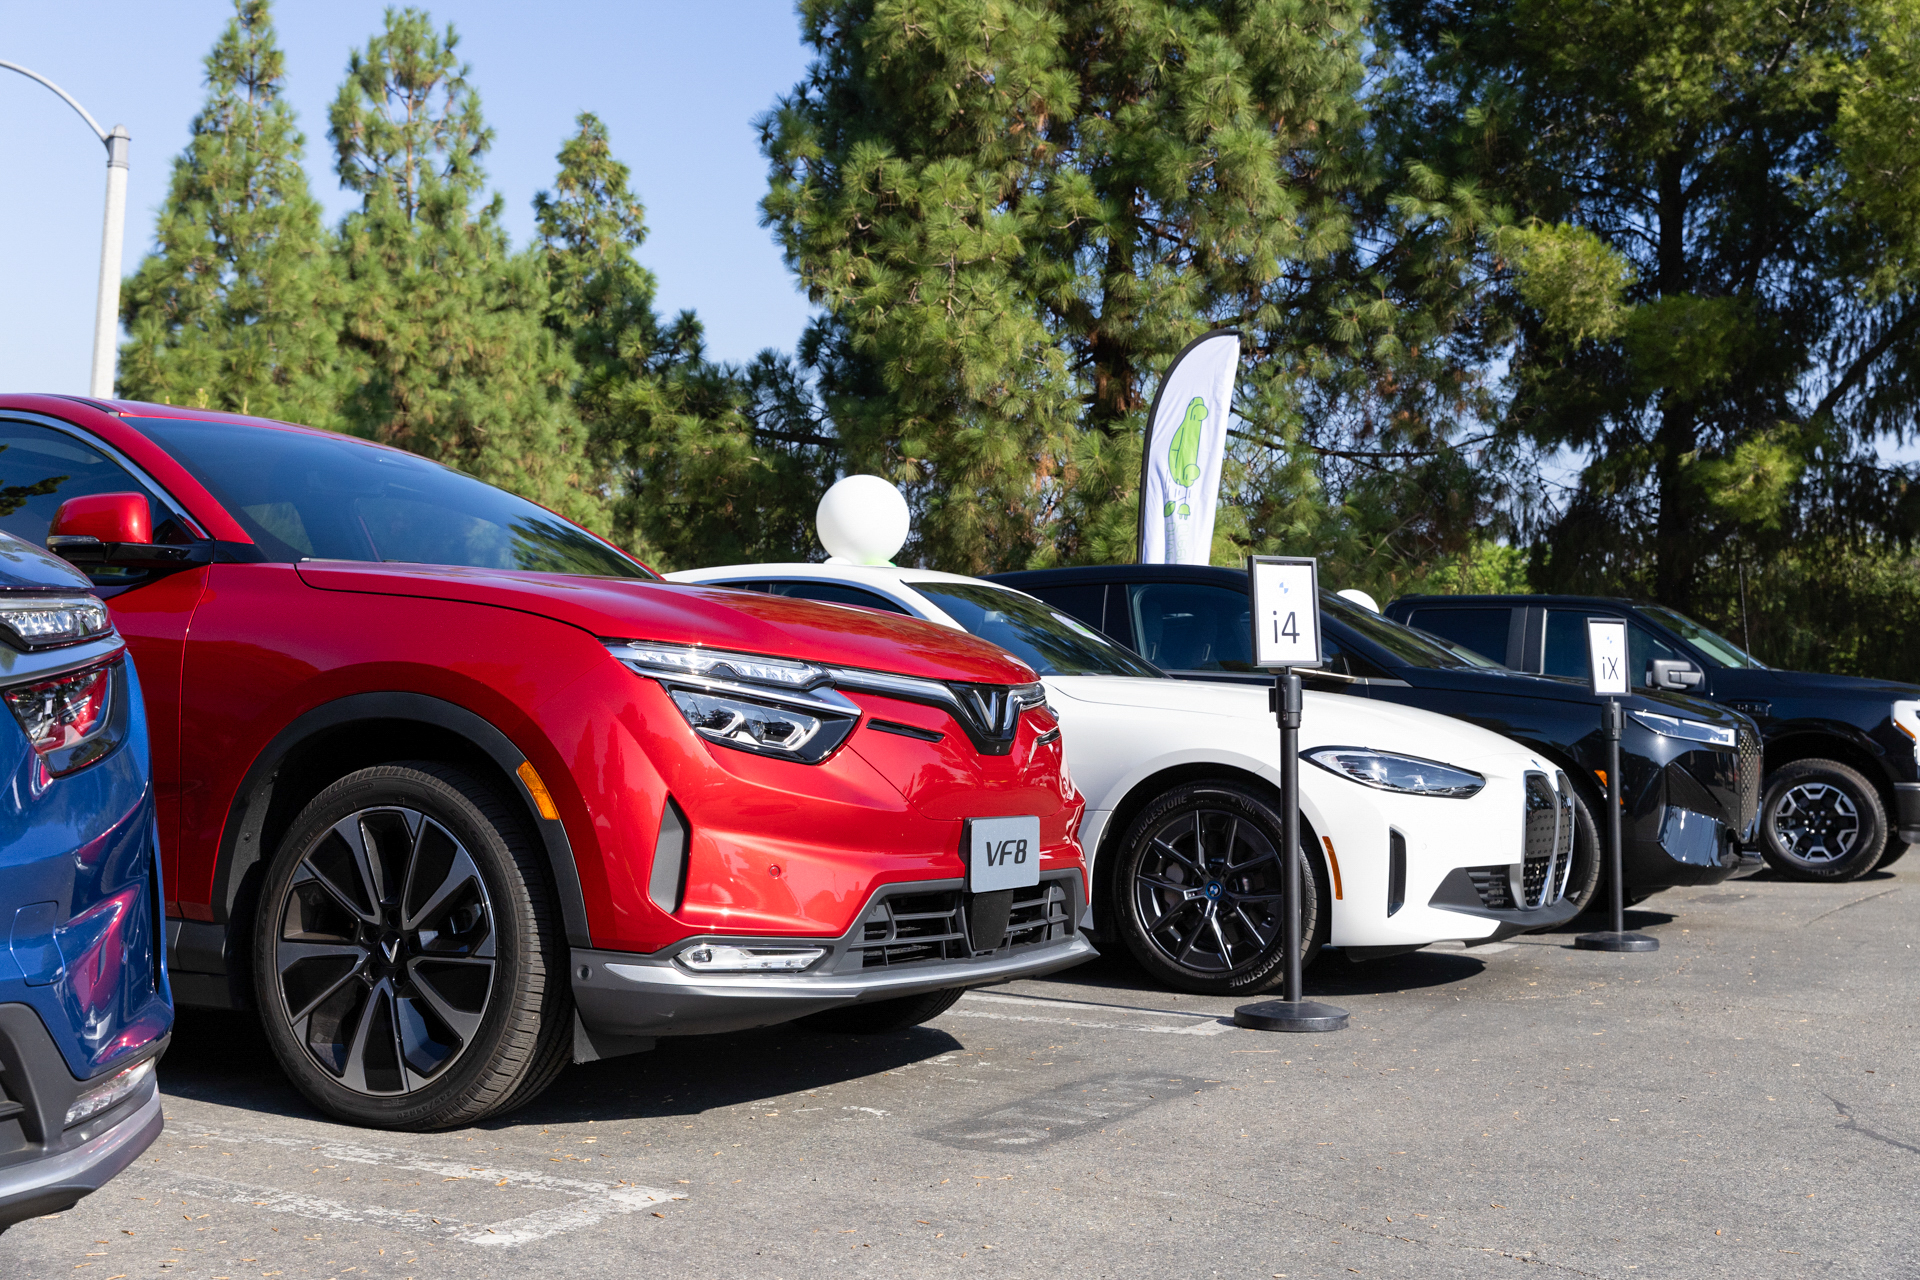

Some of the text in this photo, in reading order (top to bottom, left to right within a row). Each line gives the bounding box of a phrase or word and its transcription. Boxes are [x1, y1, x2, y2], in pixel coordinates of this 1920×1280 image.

[1272, 610, 1301, 644] i4
[1602, 656, 1619, 681] iX
[1130, 794, 1188, 849] BRIDGESTONE
[986, 839, 1028, 867] VF8
[1229, 945, 1284, 989] IDGESTONE
